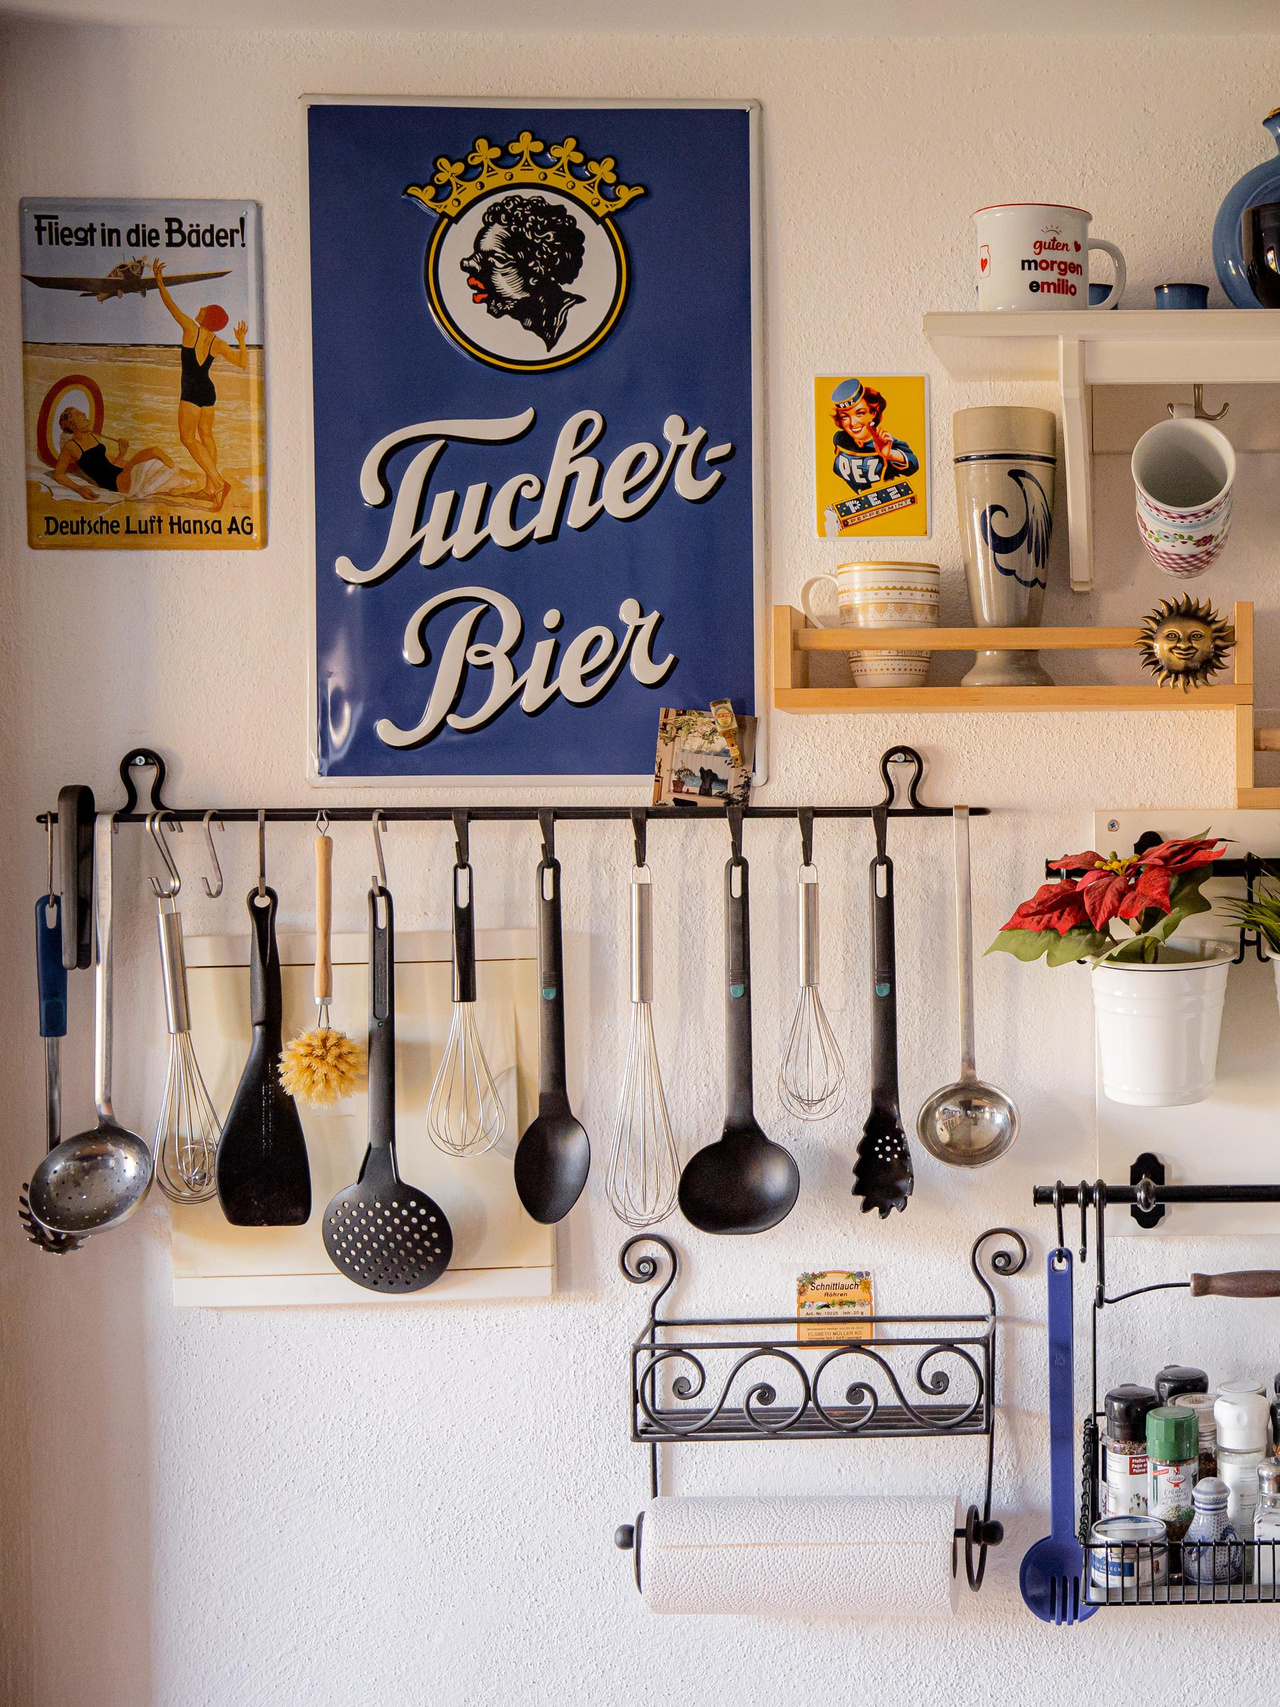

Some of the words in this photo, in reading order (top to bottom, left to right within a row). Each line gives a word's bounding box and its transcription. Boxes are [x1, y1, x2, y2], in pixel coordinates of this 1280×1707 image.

[34, 214, 97, 248] Fliegt
[100, 223, 122, 248] in
[126, 220, 161, 249] die
[165, 216, 246, 250] Bäder!
[1033, 236, 1071, 256] guten
[1021, 259, 1083, 276] morgen
[1029, 278, 1077, 296] emilio
[839, 400, 855, 409] PEZ
[839, 455, 880, 484] PEZ
[846, 486, 901, 514] PEZ
[850, 498, 911, 523] PEPPERMINT
[44, 515, 120, 536] Deutsche
[124, 515, 163, 535] Luft
[169, 515, 223, 535] Hansa
[227, 515, 254, 535] AG
[375, 586, 674, 747] Bier
[810, 1281, 859, 1291] Schnittlauch
